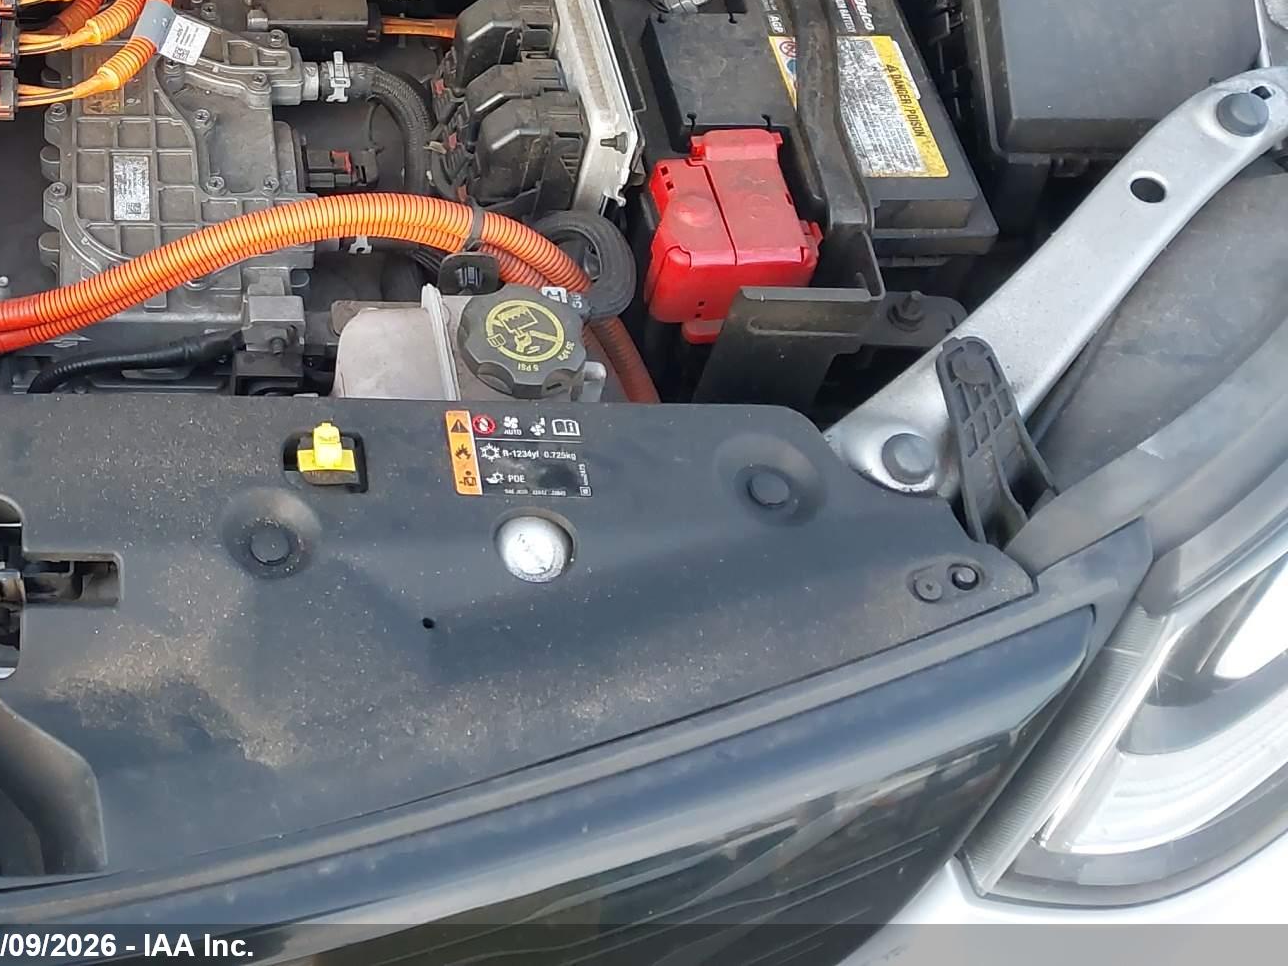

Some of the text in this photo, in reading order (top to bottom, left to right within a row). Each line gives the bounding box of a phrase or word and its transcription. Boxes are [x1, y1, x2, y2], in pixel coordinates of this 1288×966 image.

[768, 14, 785, 33] AGP
[839, 9, 857, 33] BATTERY
[890, 74, 912, 104] DANGER
[904, 109, 927, 137] POISON
[518, 363, 531, 372] PSI
[502, 450, 539, 460] R-1234yf
[508, 474, 526, 483] POE
